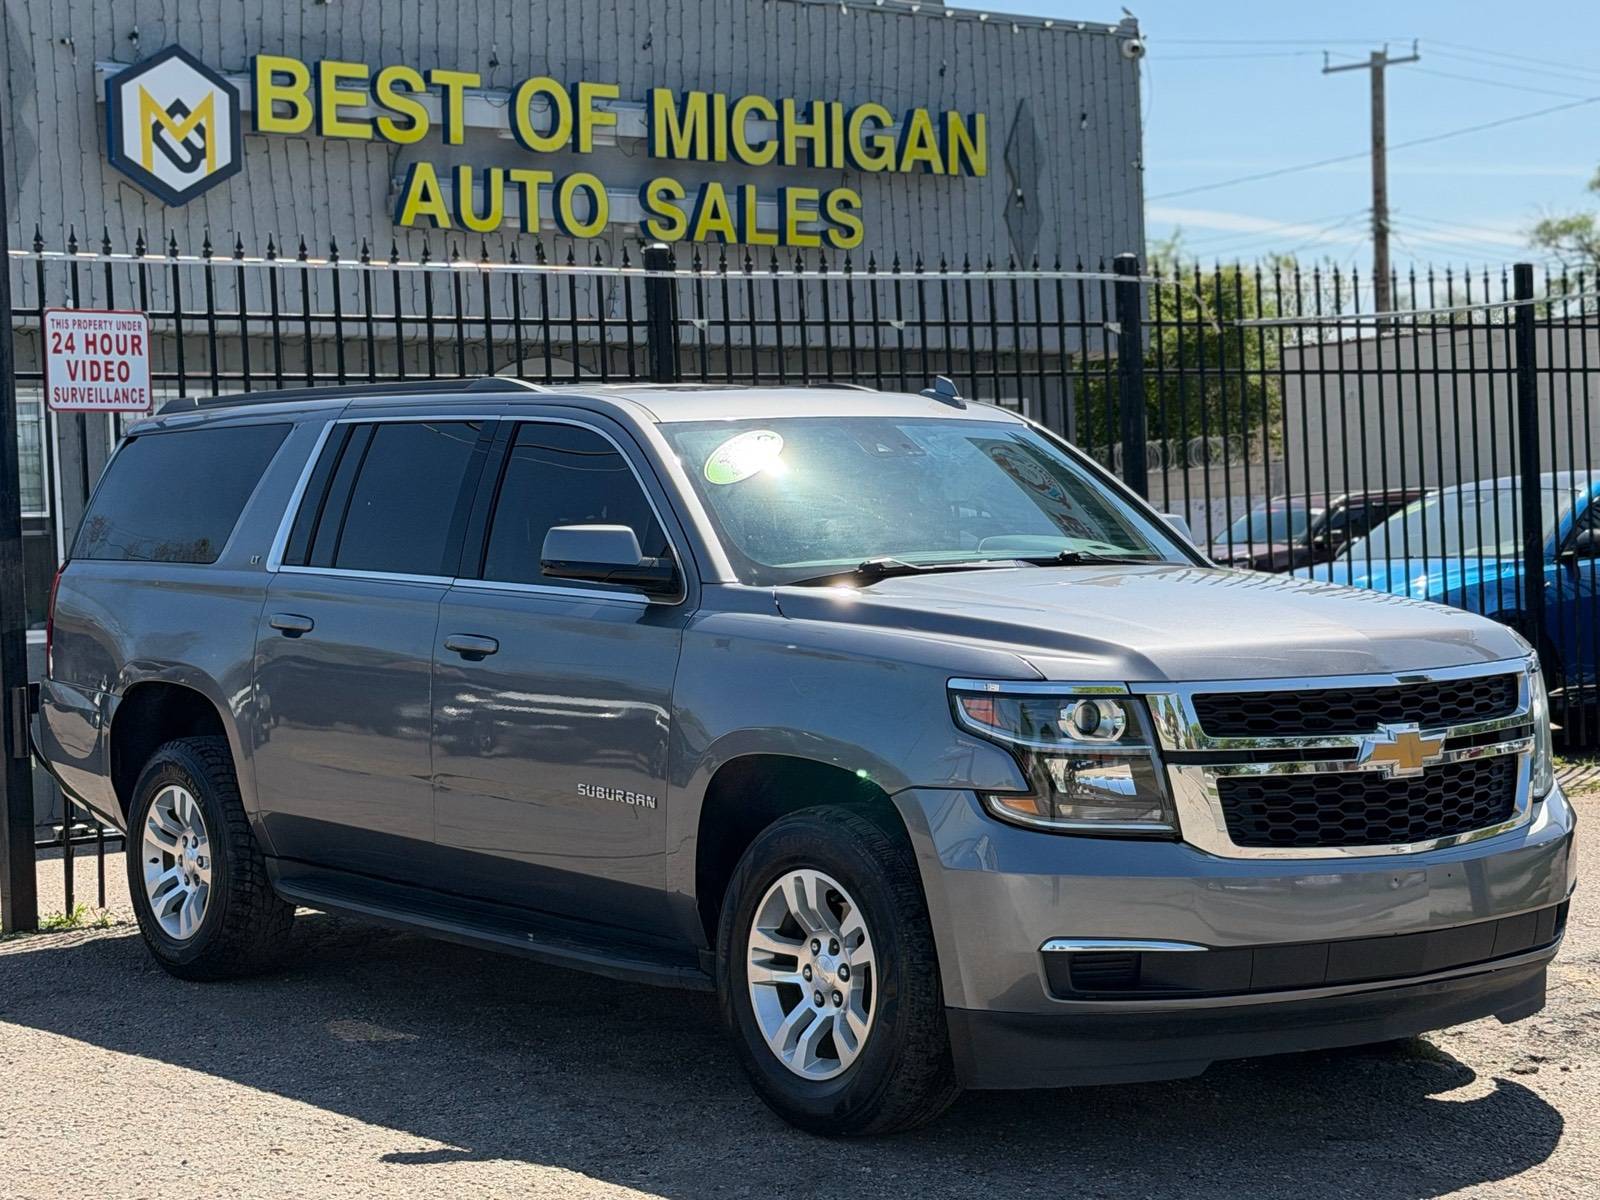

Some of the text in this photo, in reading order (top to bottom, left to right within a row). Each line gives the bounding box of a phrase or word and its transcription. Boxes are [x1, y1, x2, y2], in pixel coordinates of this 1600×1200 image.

[254, 54, 988, 177] BEST OF MICHIGAN
[398, 161, 864, 250] AUTO SALES
[50, 318, 143, 332] THIS PROPERTY UNDER
[51, 331, 143, 356] 24 HOUR
[66, 359, 130, 383] VIDEO
[53, 386, 145, 404] SURVEILLANCE
[250, 555, 261, 565] LT
[577, 783, 656, 809] SUBURBAN
